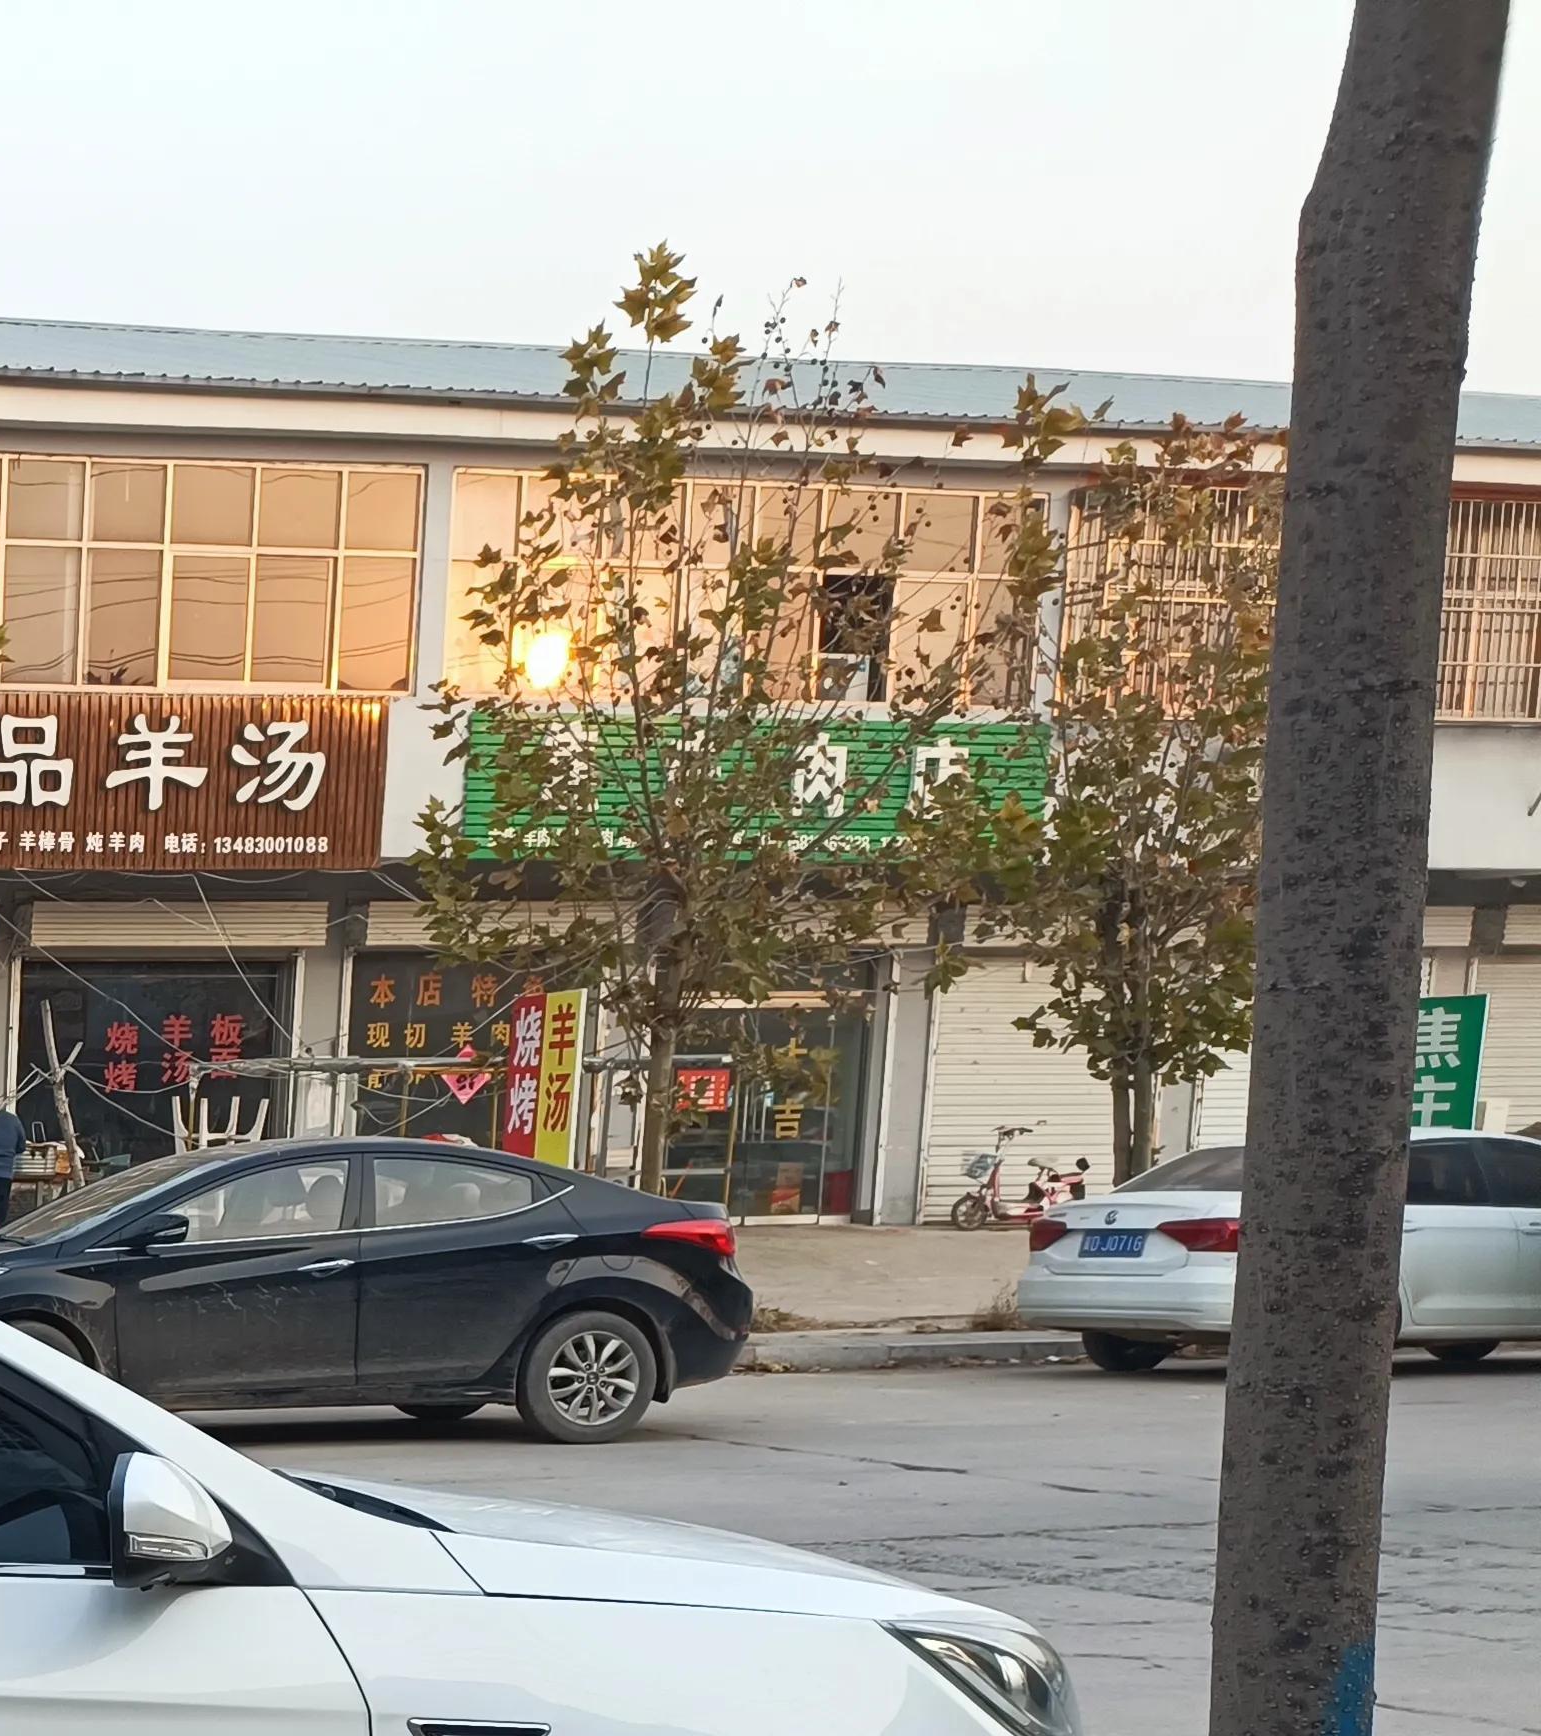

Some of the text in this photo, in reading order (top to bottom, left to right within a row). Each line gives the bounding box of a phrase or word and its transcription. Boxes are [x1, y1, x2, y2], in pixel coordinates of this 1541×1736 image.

[213, 836, 329, 854] 13483001088
[507, 1005, 544, 1136] 烧烤
[542, 1002, 577, 1133] 羊汤
